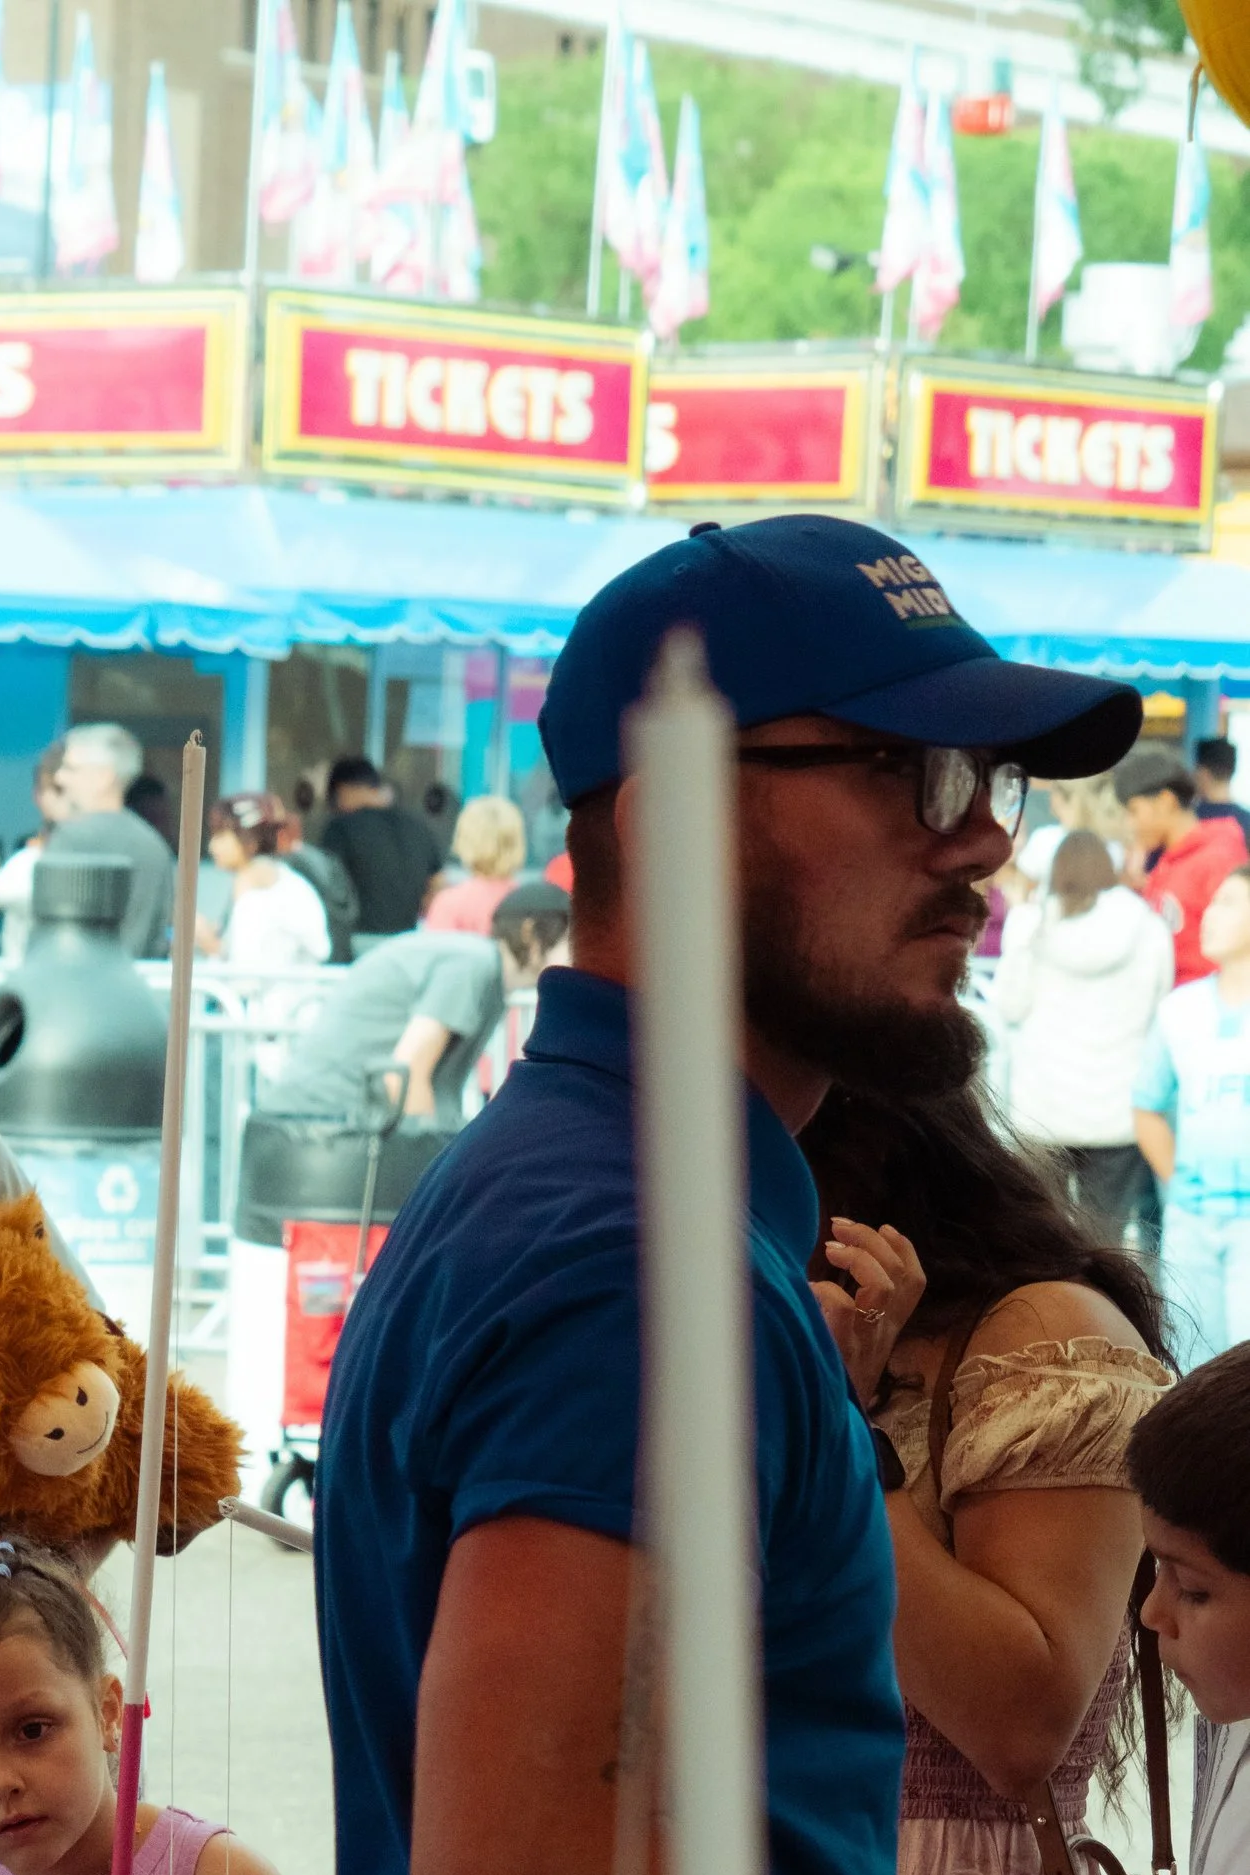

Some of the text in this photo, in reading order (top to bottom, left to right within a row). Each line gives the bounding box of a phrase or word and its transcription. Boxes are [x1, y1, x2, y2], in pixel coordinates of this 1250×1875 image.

[345, 348, 593, 443] TICKETS
[967, 408, 1175, 492] TICKETS
[855, 554, 938, 588] MIG
